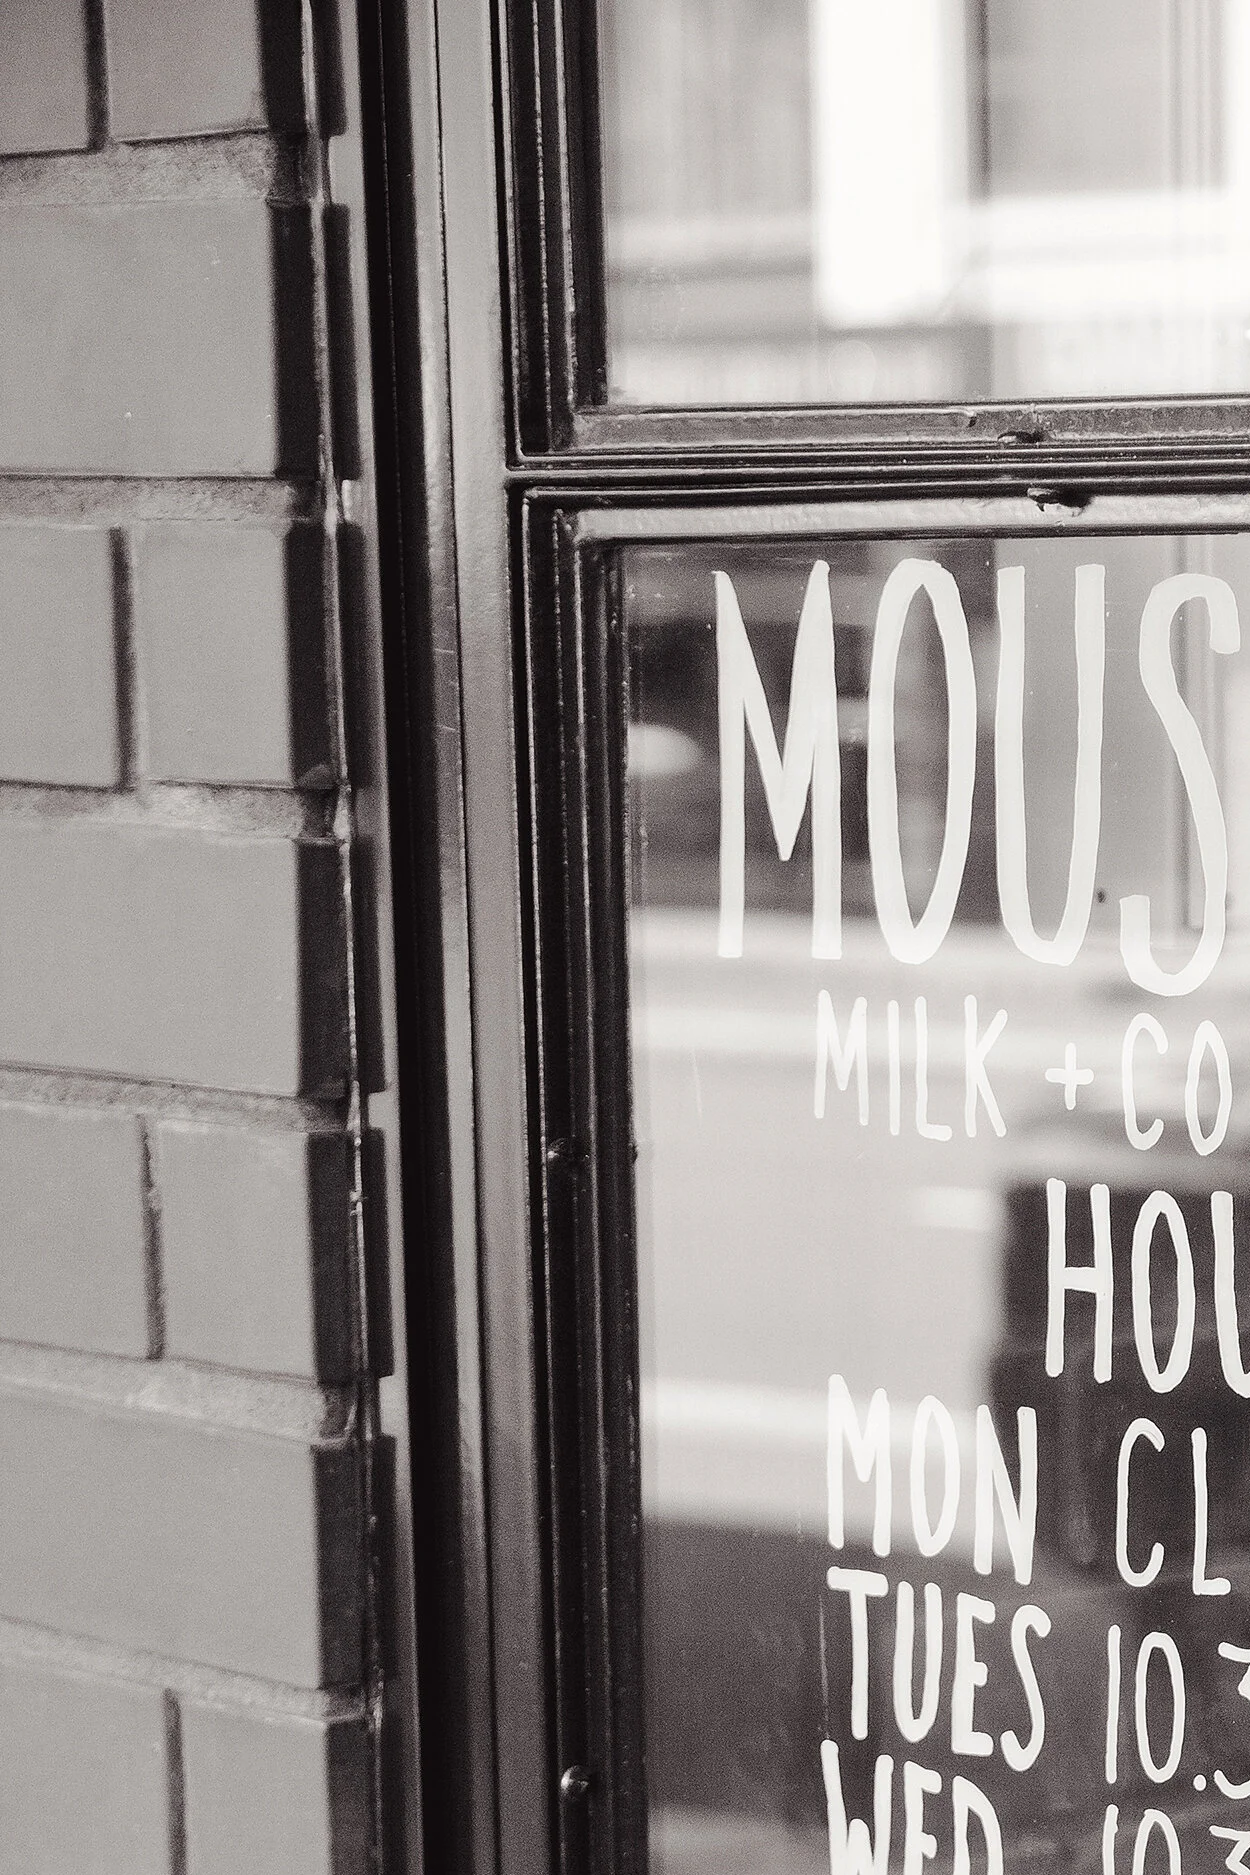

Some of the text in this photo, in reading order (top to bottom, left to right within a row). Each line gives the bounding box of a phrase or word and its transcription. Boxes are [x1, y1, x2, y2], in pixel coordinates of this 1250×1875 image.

[814, 989, 1008, 1140] MILK
[826, 1374, 1038, 1586] MON
[827, 1566, 1052, 1772] TUES
